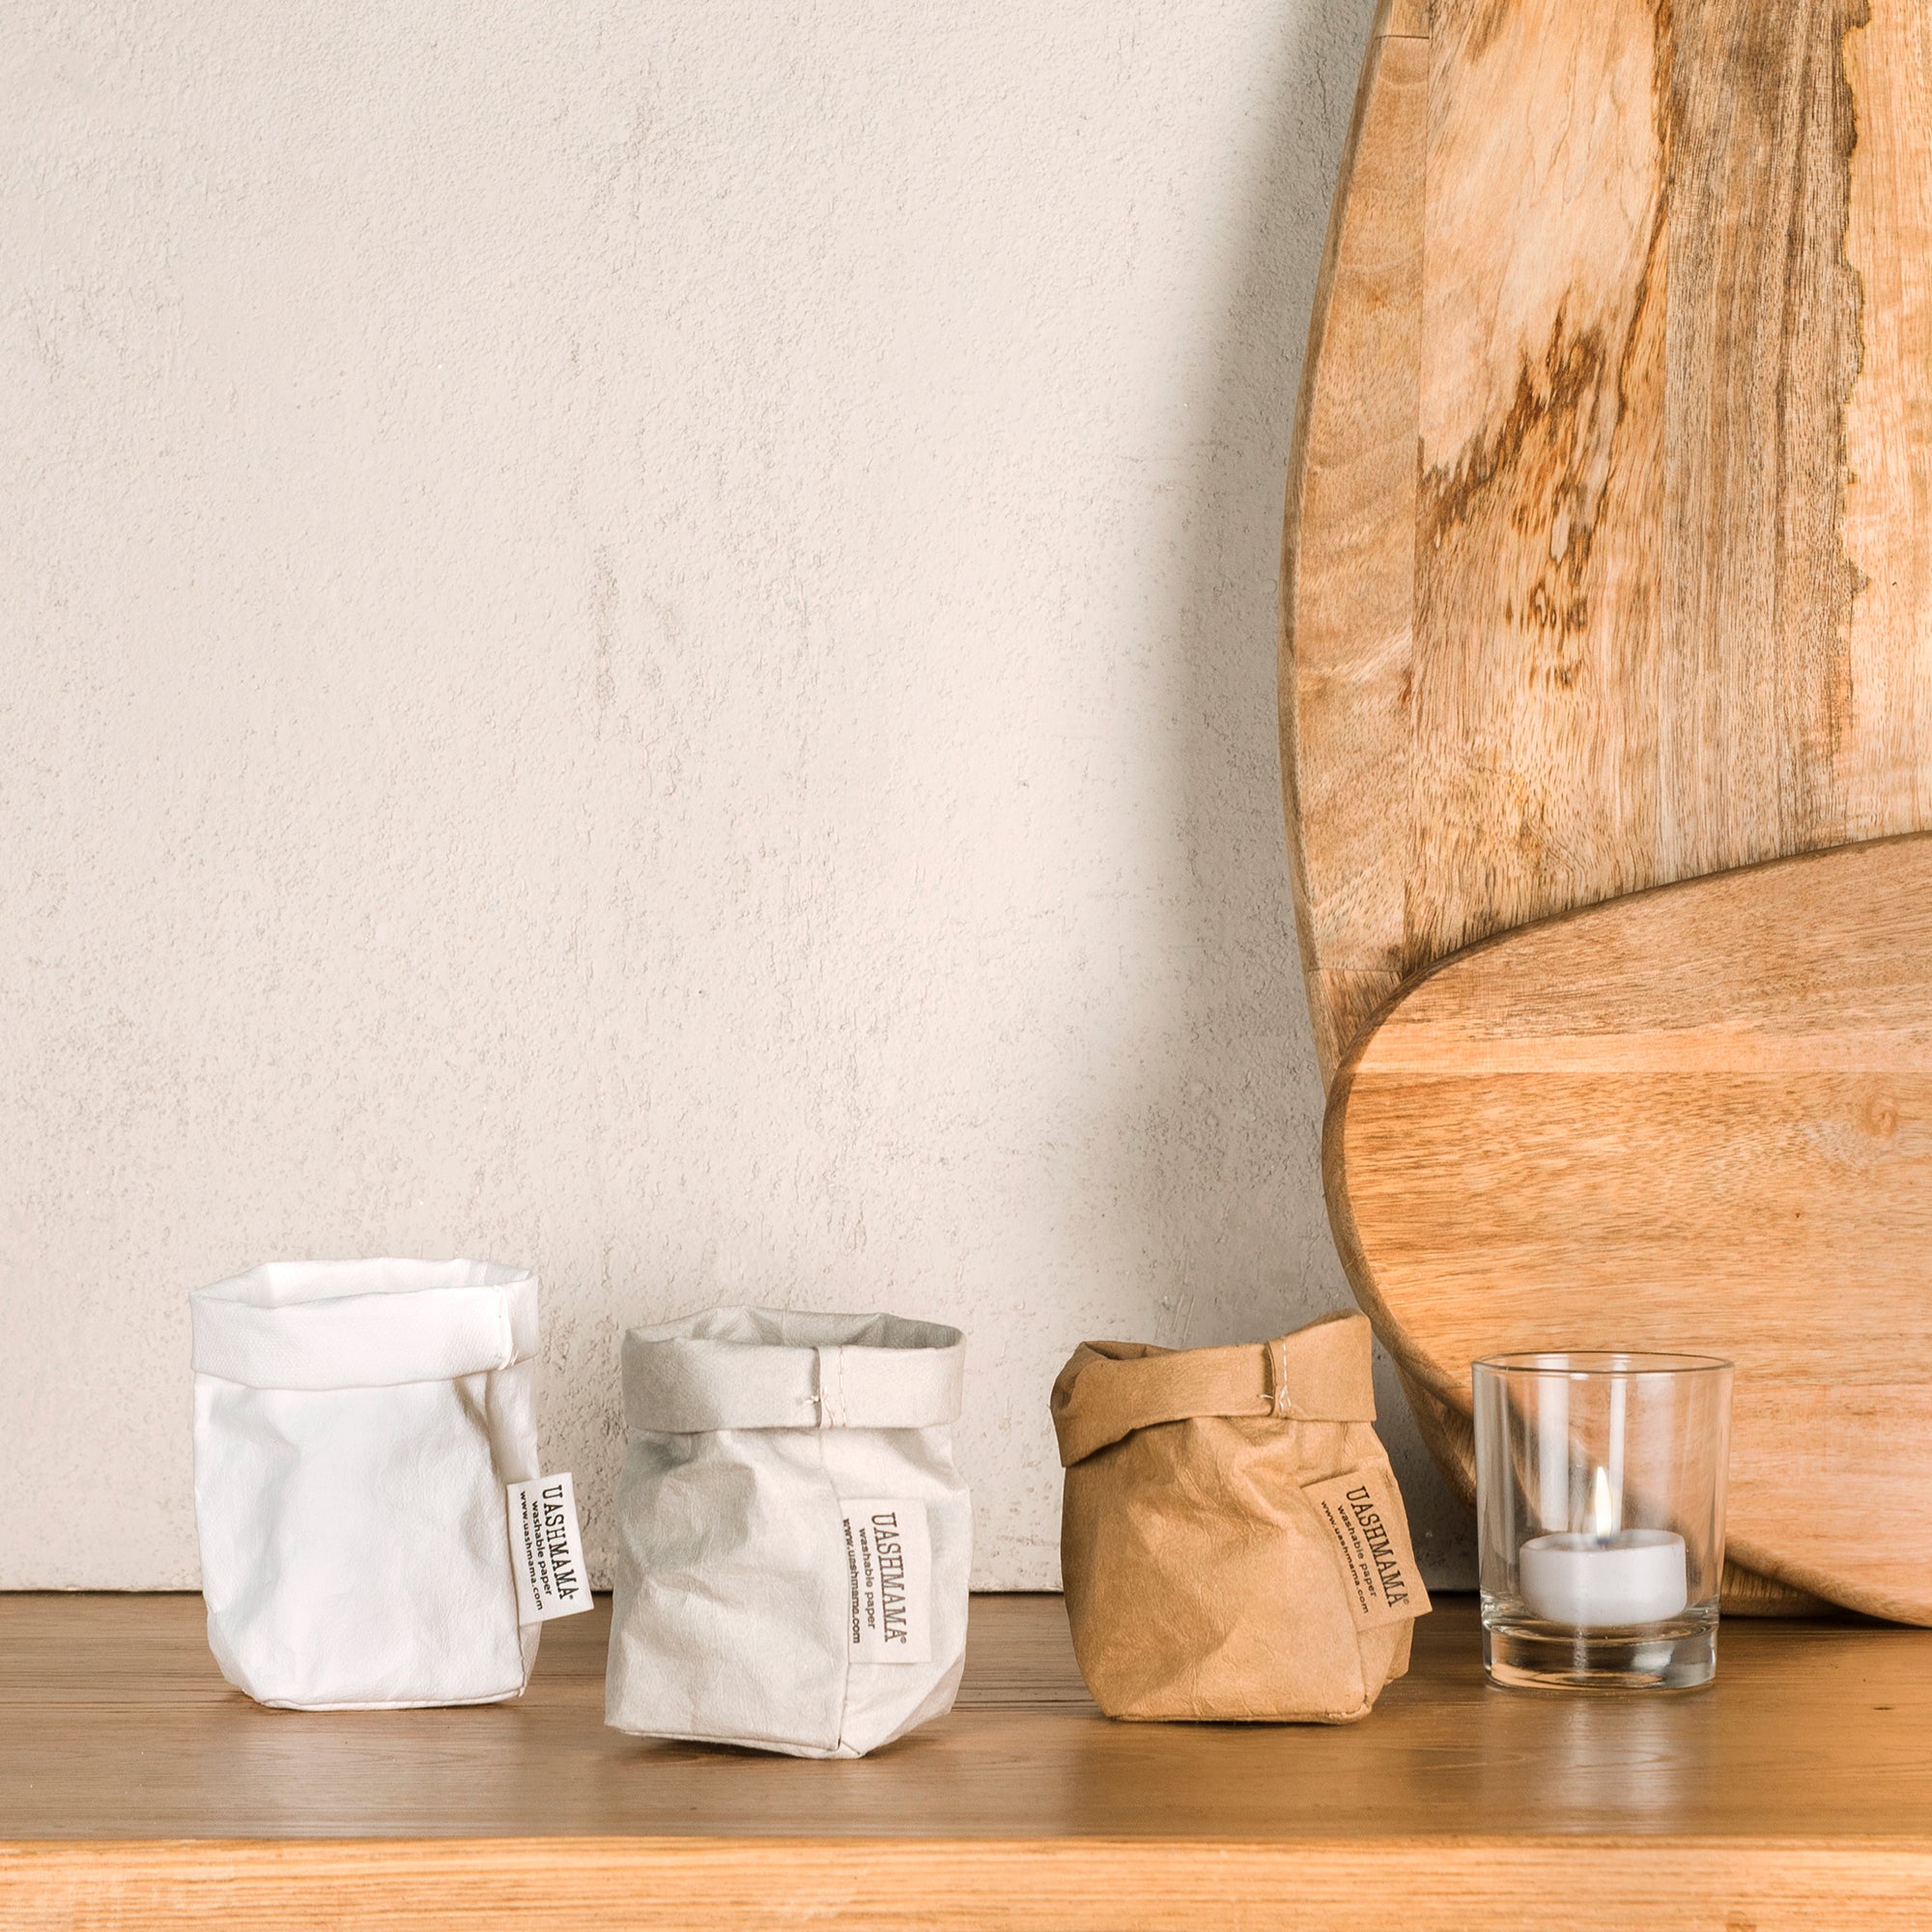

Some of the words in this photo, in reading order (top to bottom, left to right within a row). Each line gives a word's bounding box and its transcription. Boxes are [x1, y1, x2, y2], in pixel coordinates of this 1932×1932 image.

[520, 1491, 543, 1610] www.uashmama.com
[531, 1500, 546, 1558] washable
[859, 1527, 874, 1588] washable
[1321, 1500, 1369, 1614] www.uashmama.com
[1337, 1504, 1365, 1560] washable
[1359, 1563, 1378, 1598] paper
[537, 1560, 552, 1596] paper
[842, 1518, 861, 1644] www.uashmama.com
[865, 1592, 875, 1630] paper
